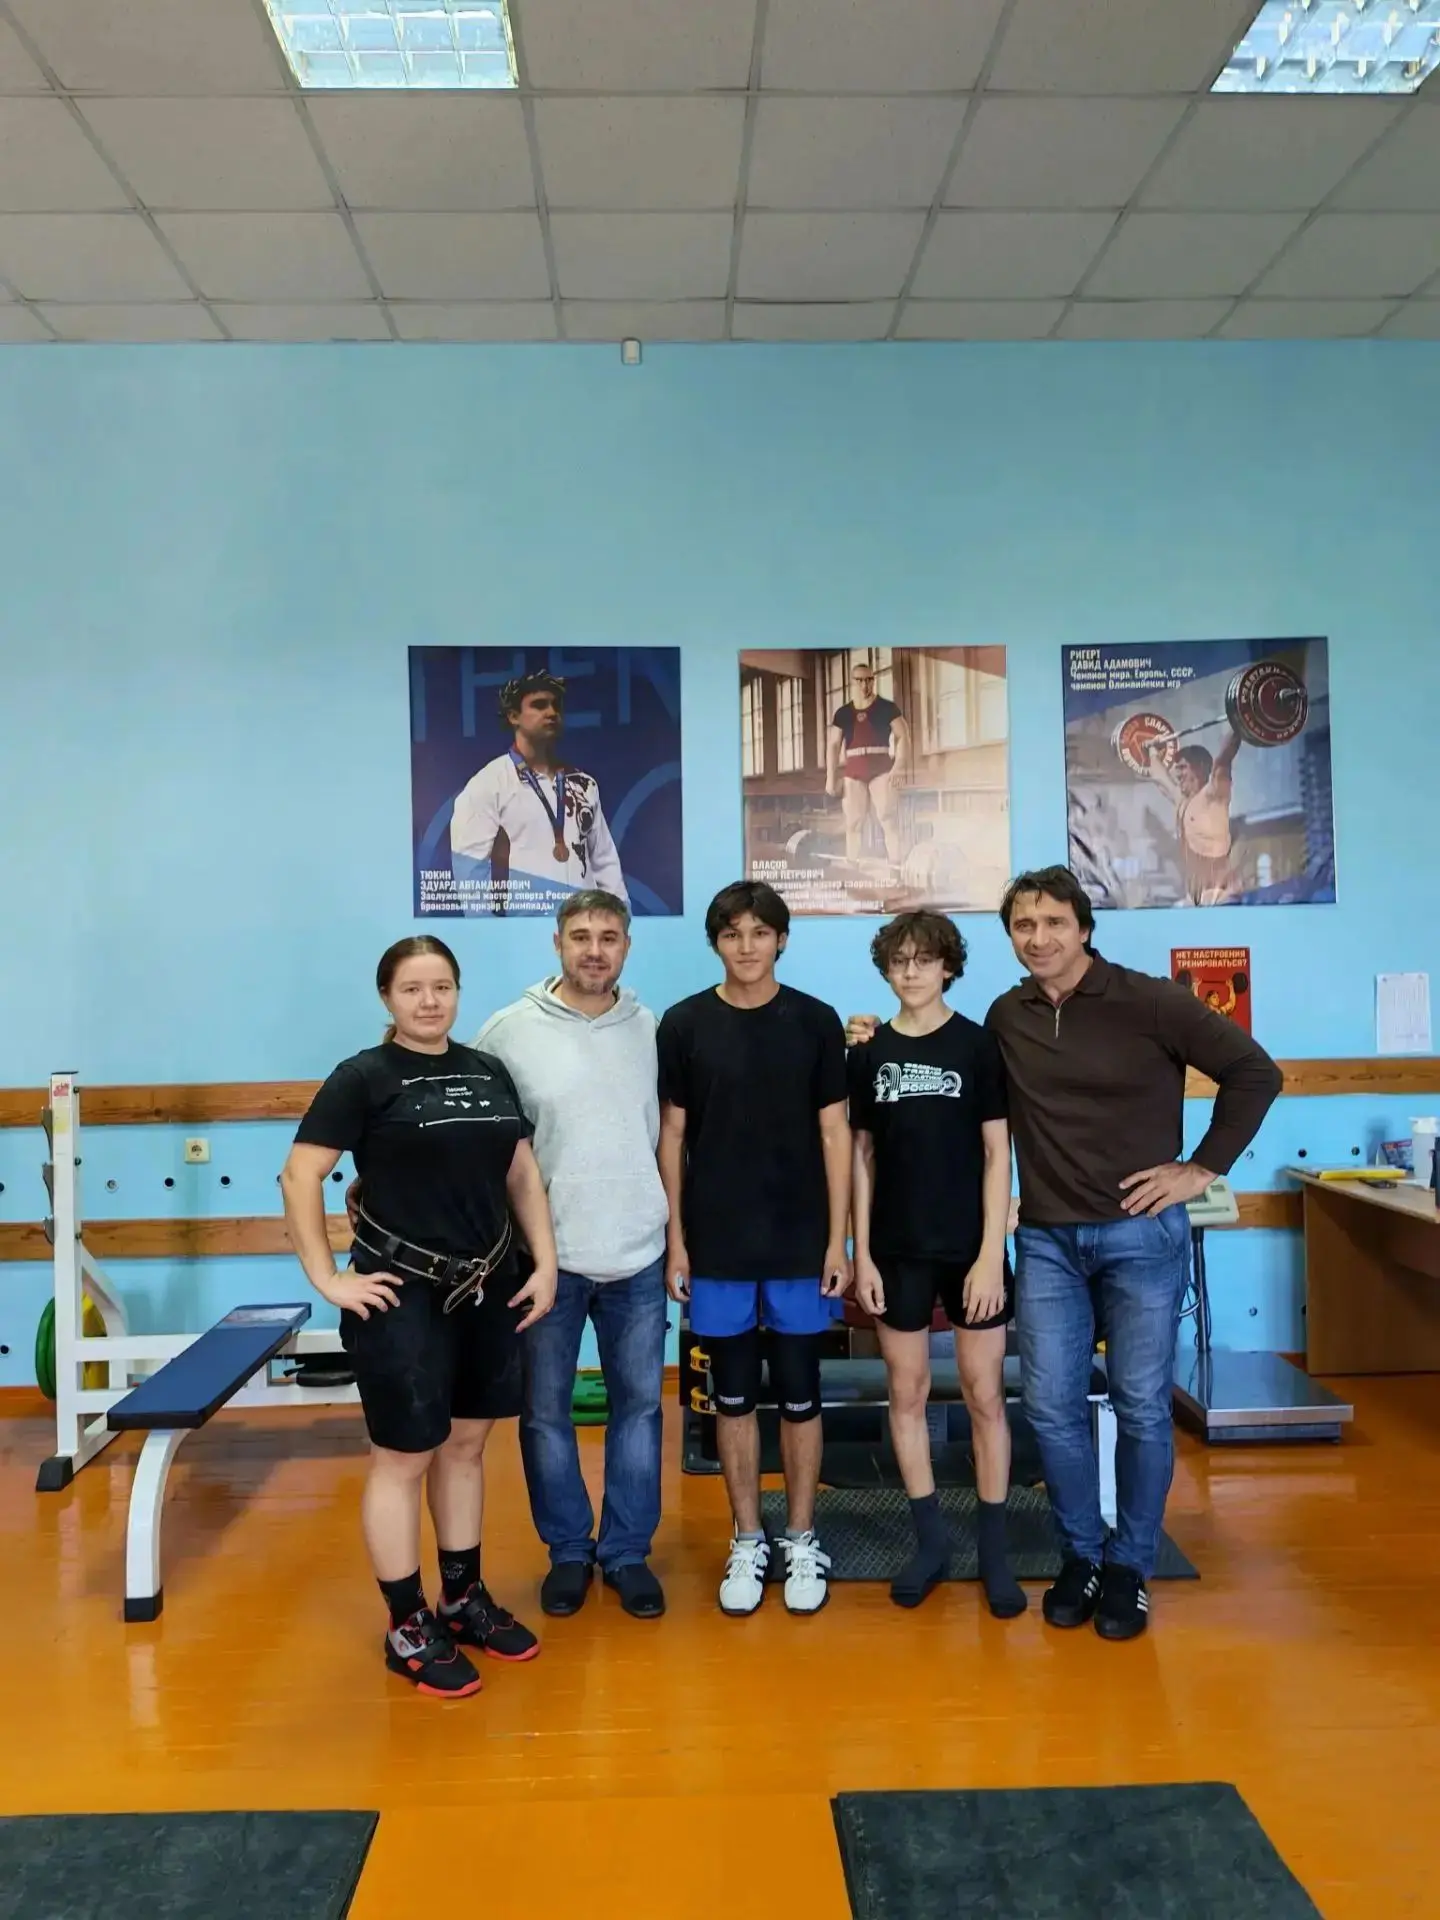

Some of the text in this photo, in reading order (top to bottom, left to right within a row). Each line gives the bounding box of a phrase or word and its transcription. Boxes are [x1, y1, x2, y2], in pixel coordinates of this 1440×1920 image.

[1070, 649, 1100, 660] РИГЕРТ
[1071, 658, 1152, 671] ДАВИД АДАМОВИЧ
[752, 859, 788, 870] ВЛАСОВ
[420, 870, 452, 880] ТЮКИН
[752, 870, 778, 880] ЮРИЙ
[420, 880, 531, 891] ЭДУАРД АВТАНДИЛОВИЧ
[420, 891, 480, 901] Заслуженный
[482, 892, 513, 901] мастер
[420, 901, 468, 911] бронзовый
[503, 900, 555, 911] Олимпиады
[1176, 950, 1246, 959] НЕТ НАСТРОЕНИЯ
